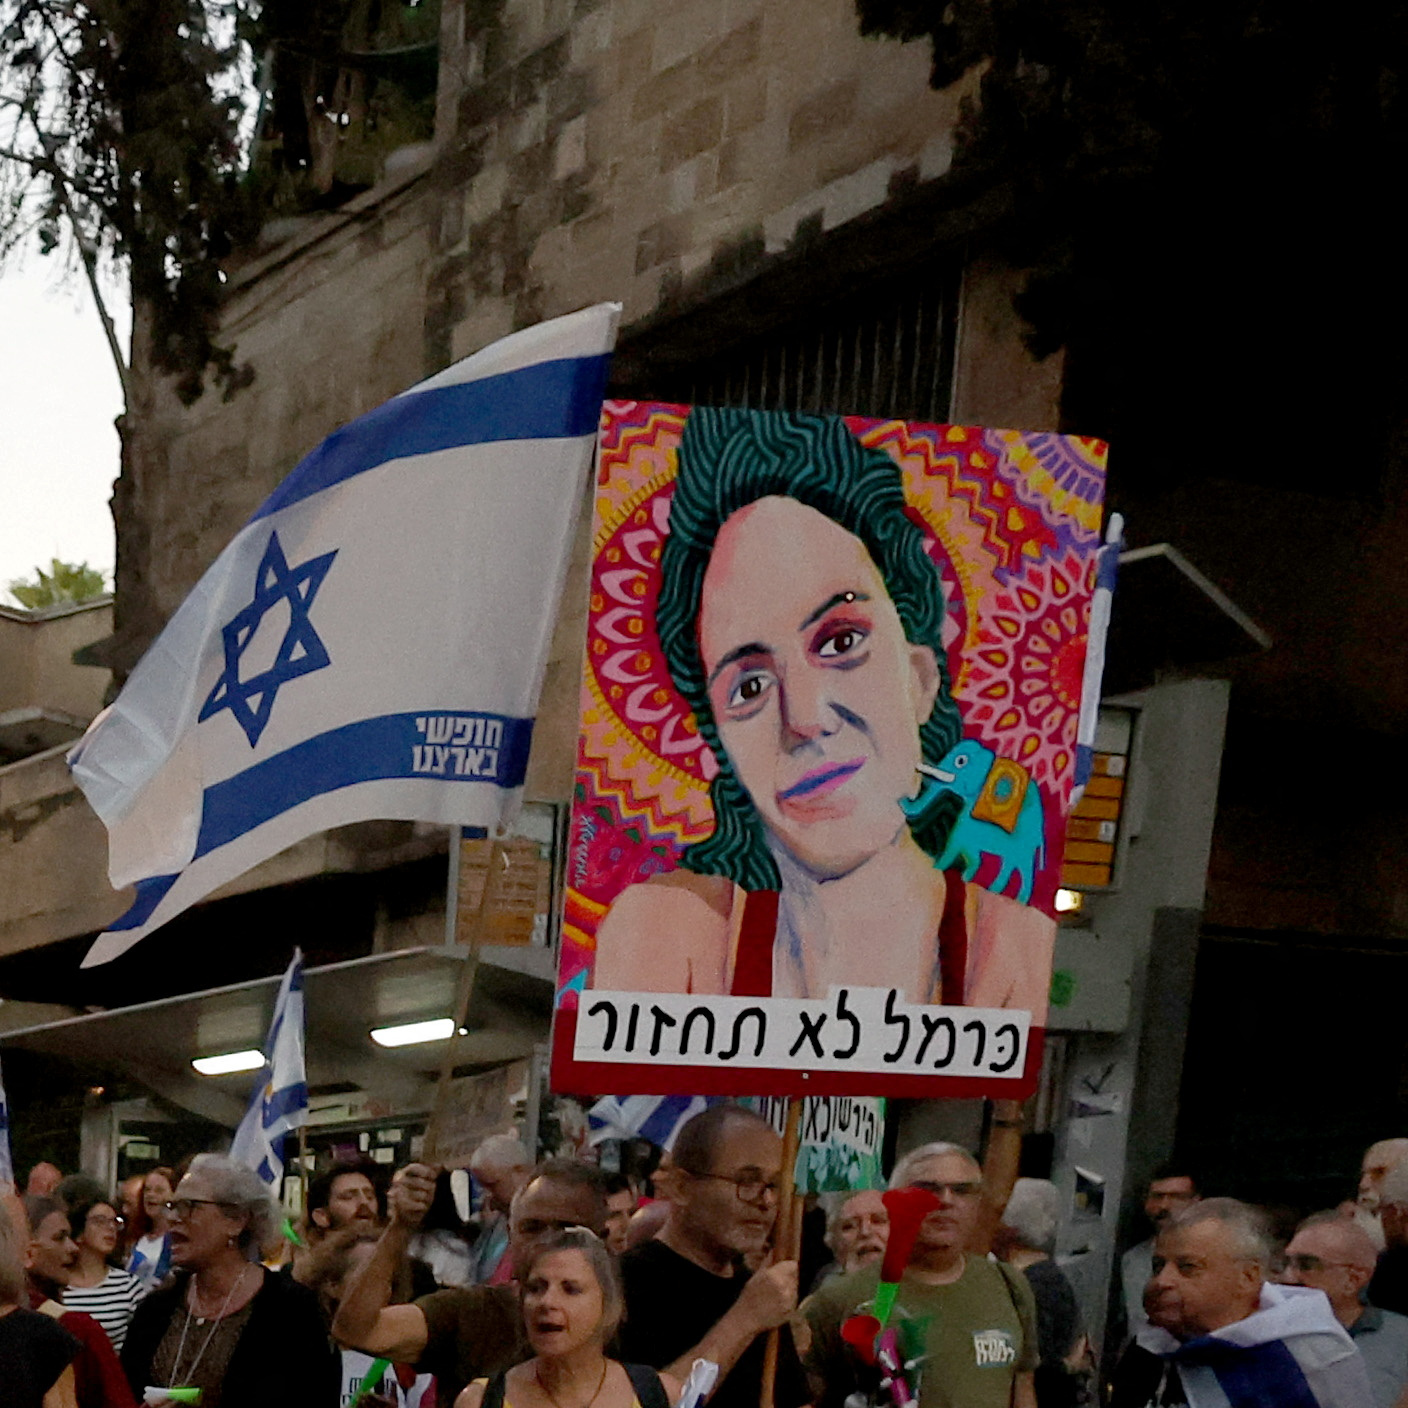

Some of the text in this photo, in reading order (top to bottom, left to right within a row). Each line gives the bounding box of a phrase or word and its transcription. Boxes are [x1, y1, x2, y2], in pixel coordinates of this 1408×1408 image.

[416, 716, 504, 748] חופשי
[412, 744, 498, 777] בארצנו
[588, 1001, 767, 1060] תחזור
[789, 989, 861, 1060] לא
